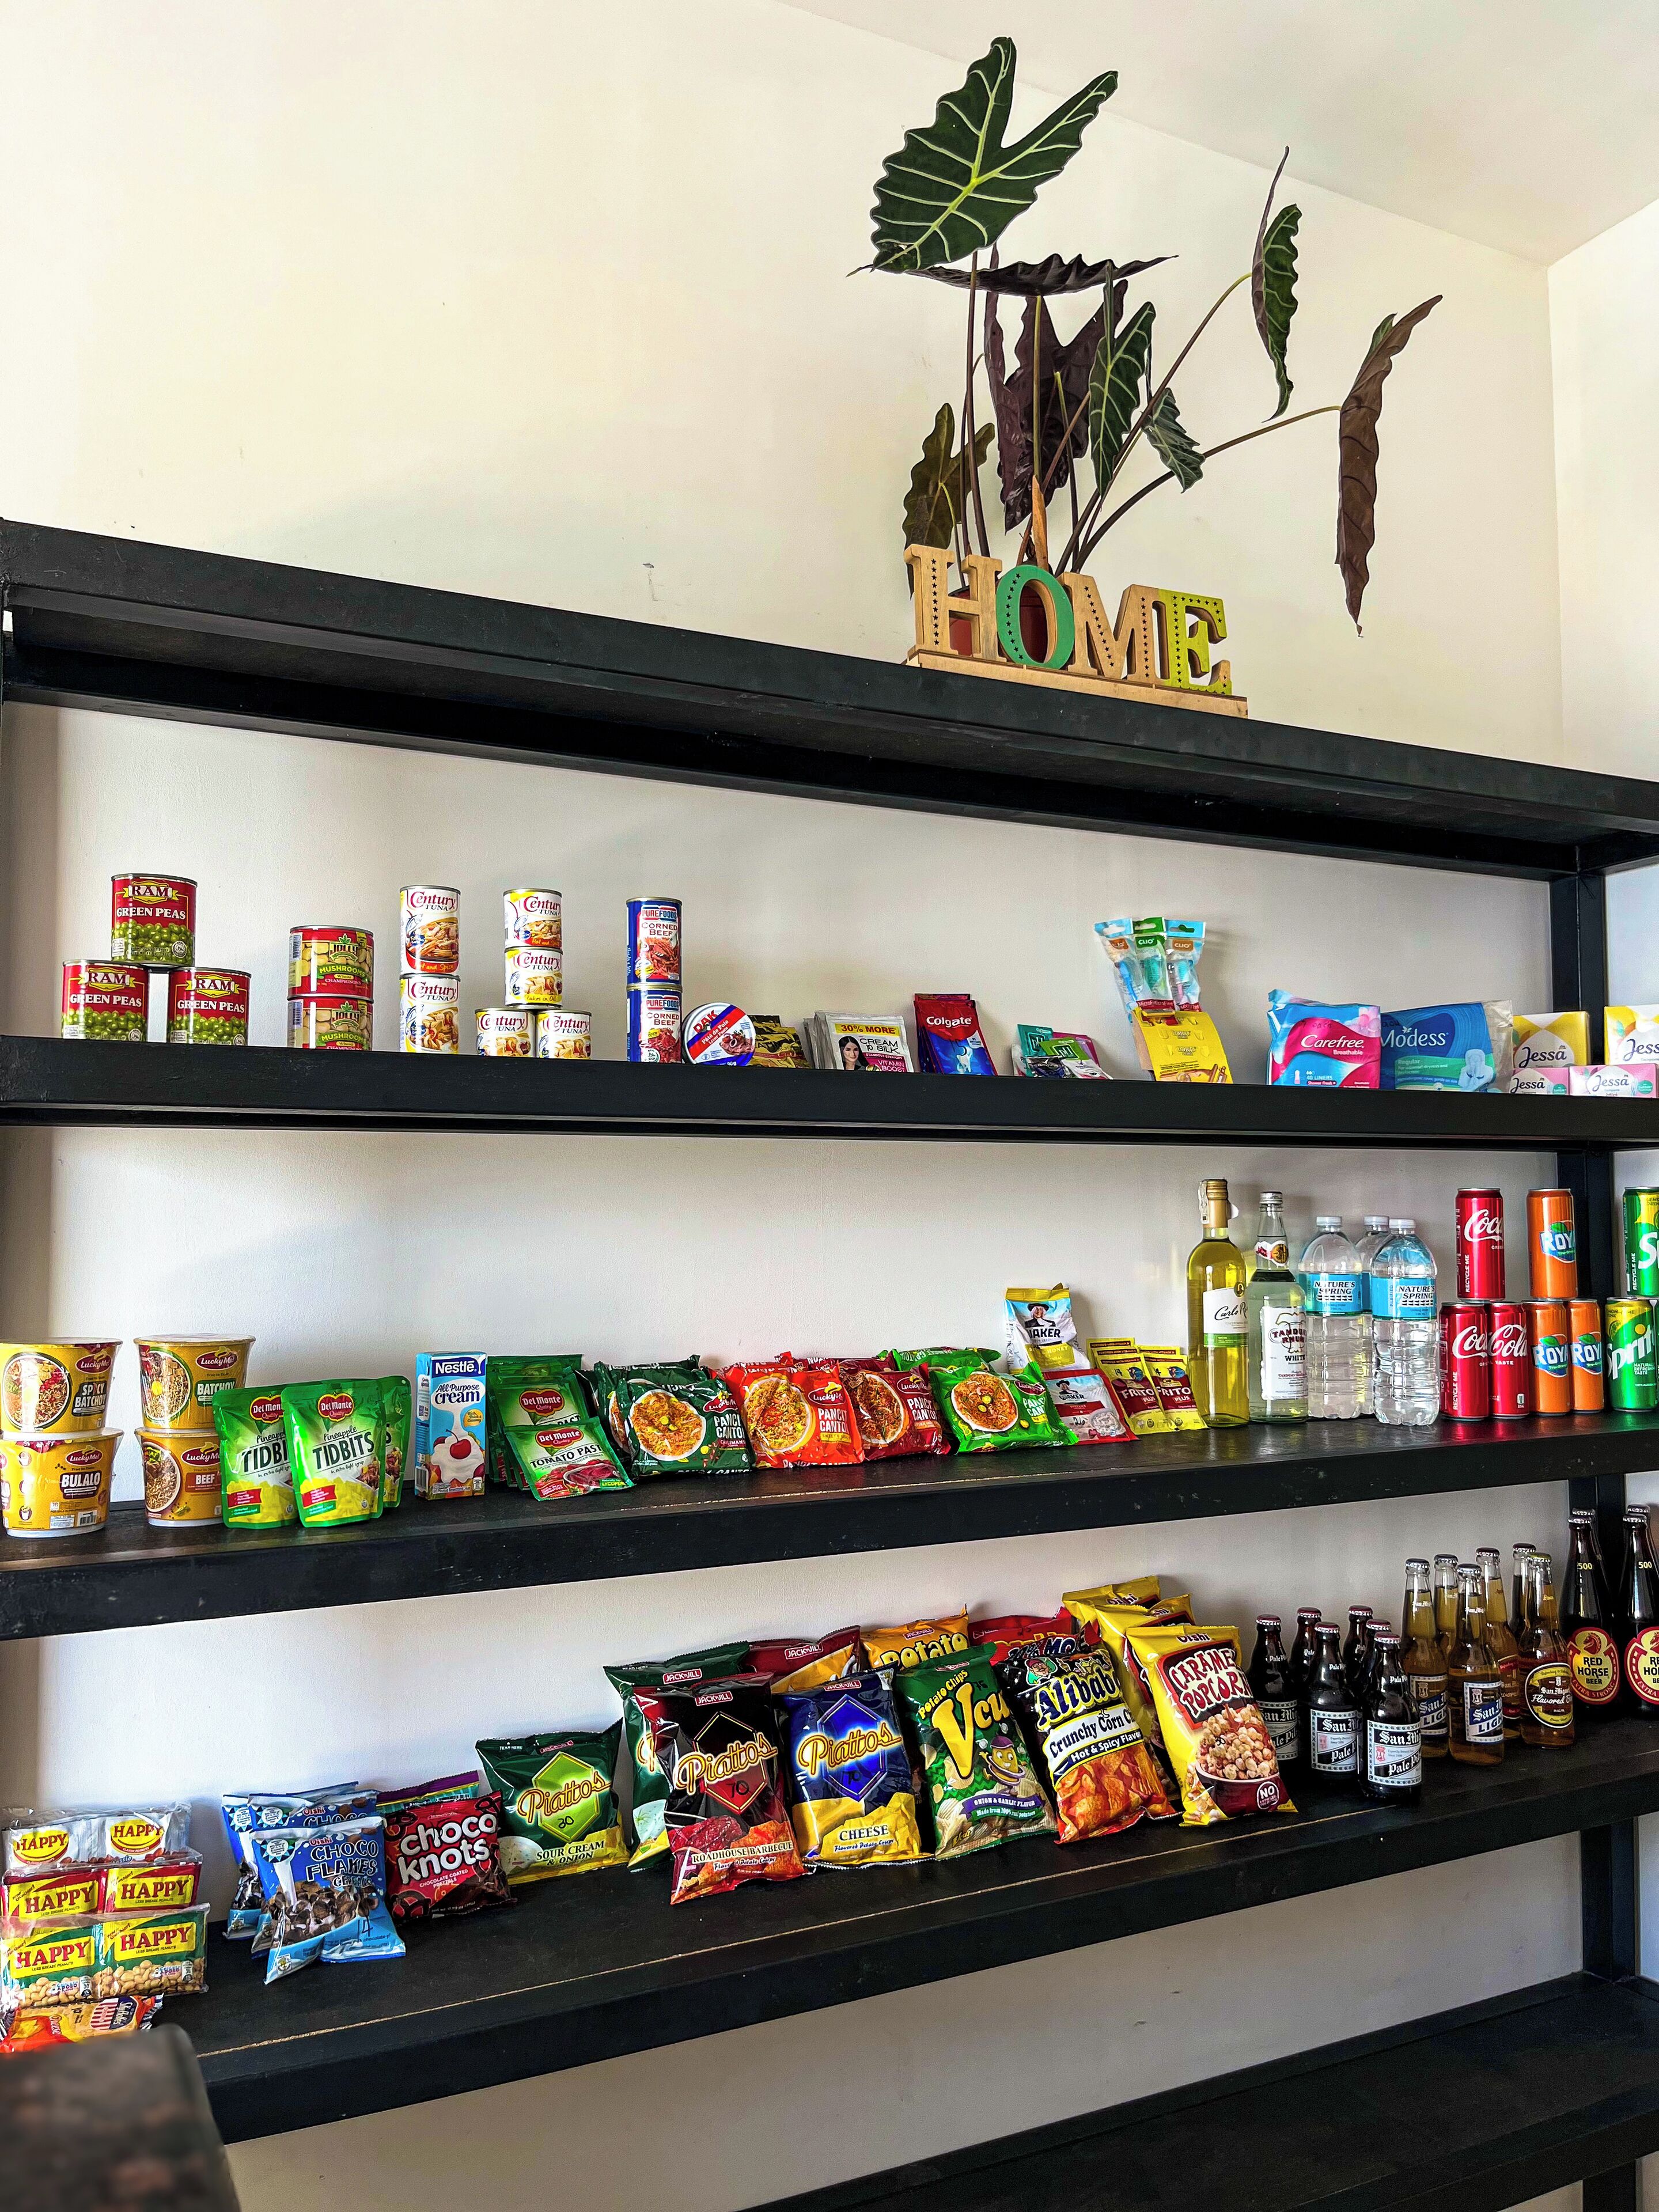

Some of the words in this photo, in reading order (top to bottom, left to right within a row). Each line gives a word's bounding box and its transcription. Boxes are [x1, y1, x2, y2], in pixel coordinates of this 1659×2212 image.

[904, 544, 1233, 695] HOME
[131, 884, 172, 898] RAM
[410, 891, 456, 910] Century
[116, 907, 154, 918] GREEN
[156, 908, 186, 921] PEAS
[642, 909, 677, 919] PUREFOODS
[641, 922, 677, 931] CORNED
[331, 943, 358, 956] JOLLY
[517, 952, 560, 969] Century
[89, 972, 128, 984] RAM
[319, 965, 366, 978] MUSHROOMS
[195, 978, 233, 992] RAM
[411, 982, 456, 1001] Century
[70, 994, 109, 1005] GREEN
[112, 995, 143, 1007] PEAS
[177, 999, 217, 1011] GREEN
[218, 1000, 245, 1014] PEAS
[646, 999, 679, 1008] PUREFOODS
[332, 1010, 360, 1022] JOLLY
[646, 1012, 679, 1020] CORNED
[693, 1010, 718, 1033] DAK
[926, 1016, 972, 1028] Colgate
[841, 1024, 863, 1032] 30%
[866, 1025, 895, 1035] MORE
[321, 1032, 367, 1044] MUSHROOMS
[859, 1037, 898, 1047] CREAM
[1301, 1034, 1364, 1048] Carefree
[1381, 1027, 1446, 1048] Modess
[877, 1045, 899, 1054] SILK
[878, 1059, 904, 1068] VITAMIN
[1510, 1077, 1546, 1094] Jessa
[1592, 1074, 1629, 1092] Jessa
[1465, 1254, 1469, 1263] ME
[1631, 1252, 1636, 1263] ME
[1214, 1304, 1239, 1321] Carlo
[1282, 1336, 1305, 1344] RHUM
[435, 1361, 475, 1374] Nestlé
[1453, 1371, 1457, 1381] ME
[82, 1382, 105, 1396] SPICY
[436, 1384, 449, 1393] All
[450, 1384, 479, 1393] Purpose
[1122, 1388, 1154, 1399] FRITO
[1156, 1387, 1191, 1395] FRITO
[435, 1390, 480, 1404] cream
[522, 1397, 536, 1405] Del
[537, 1396, 561, 1404] Monte
[321, 1403, 331, 1411] Del
[331, 1402, 353, 1410] Monte
[714, 1413, 741, 1427] PANCI
[818, 1408, 847, 1421] PANCIT
[324, 1426, 357, 1441] Pineapple
[819, 1420, 849, 1433] CANTO
[539, 1434, 554, 1442] Del
[555, 1430, 580, 1439] Monte
[312, 1431, 374, 1469] TIDBITS
[530, 1452, 575, 1468] TOMATO
[577, 1444, 602, 1456] PAST
[61, 1472, 101, 1488] BULALO
[195, 1474, 215, 1485] BEEF
[1578, 1562, 1593, 1570] 500
[1638, 1561, 1653, 1569] 500
[1583, 1657, 1603, 1667] RED
[1390, 1675, 1402, 1683] Pale
[1577, 1666, 1608, 1678] HORSE
[918, 1687, 948, 1719] Potato
[945, 1669, 969, 1691] Chips
[1572, 1679, 1590, 1696] EXTRA
[1592, 1682, 1615, 1698] STRONG
[1531, 1694, 1565, 1705] Flavored
[1473, 1706, 1494, 1722] San
[1322, 1718, 1347, 1732] San
[1049, 1722, 1097, 1758] Crunchy
[1097, 1709, 1125, 1733] Corn
[1379, 1730, 1404, 1745] San
[798, 1721, 903, 1776] Piattos
[1071, 1749, 1089, 1763] Hot
[1090, 1745, 1098, 1753] &
[1099, 1738, 1120, 1753] Spicy
[1331, 1747, 1351, 1763] Pale
[676, 1732, 778, 1796] Piattos
[1388, 1759, 1410, 1776] Pale
[517, 1771, 612, 1824] Piattos
[1260, 1786, 1275, 1797] NO
[974, 1797, 993, 1805] ONION
[998, 1797, 1017, 1806] GARLIC
[1017, 1800, 1035, 1808] FLAVOR
[303, 1806, 325, 1815] Oishi
[976, 1808, 989, 1816] Made
[1001, 1807, 1012, 1815] 100%
[113, 1824, 165, 1838] HAPPY
[400, 1813, 497, 1856] choco
[839, 1825, 889, 1841] CHEESE
[16, 1833, 69, 1851] HAPPY
[309, 1837, 333, 1846] Oishi
[834, 1843, 858, 1851] Flavored
[310, 1839, 379, 1862] CHOCO
[536, 1847, 565, 1861] SOUR
[567, 1840, 605, 1854] CREAM
[559, 1851, 594, 1864] ONION
[692, 1847, 748, 1863] ROADHOUSE
[749, 1841, 793, 1855] BARBECUE
[397, 1838, 490, 1885] knots
[305, 1857, 378, 1883] FLAKES
[419, 1874, 449, 1888] CHOCOLATE
[449, 1869, 468, 1878] COATED
[433, 1877, 457, 1889] PRETZELS
[121, 1879, 190, 1900] HAPPY
[25, 1881, 95, 1914] HAPPY
[120, 1924, 194, 1952] HAPPY
[16, 1938, 91, 1969] HAPPY
